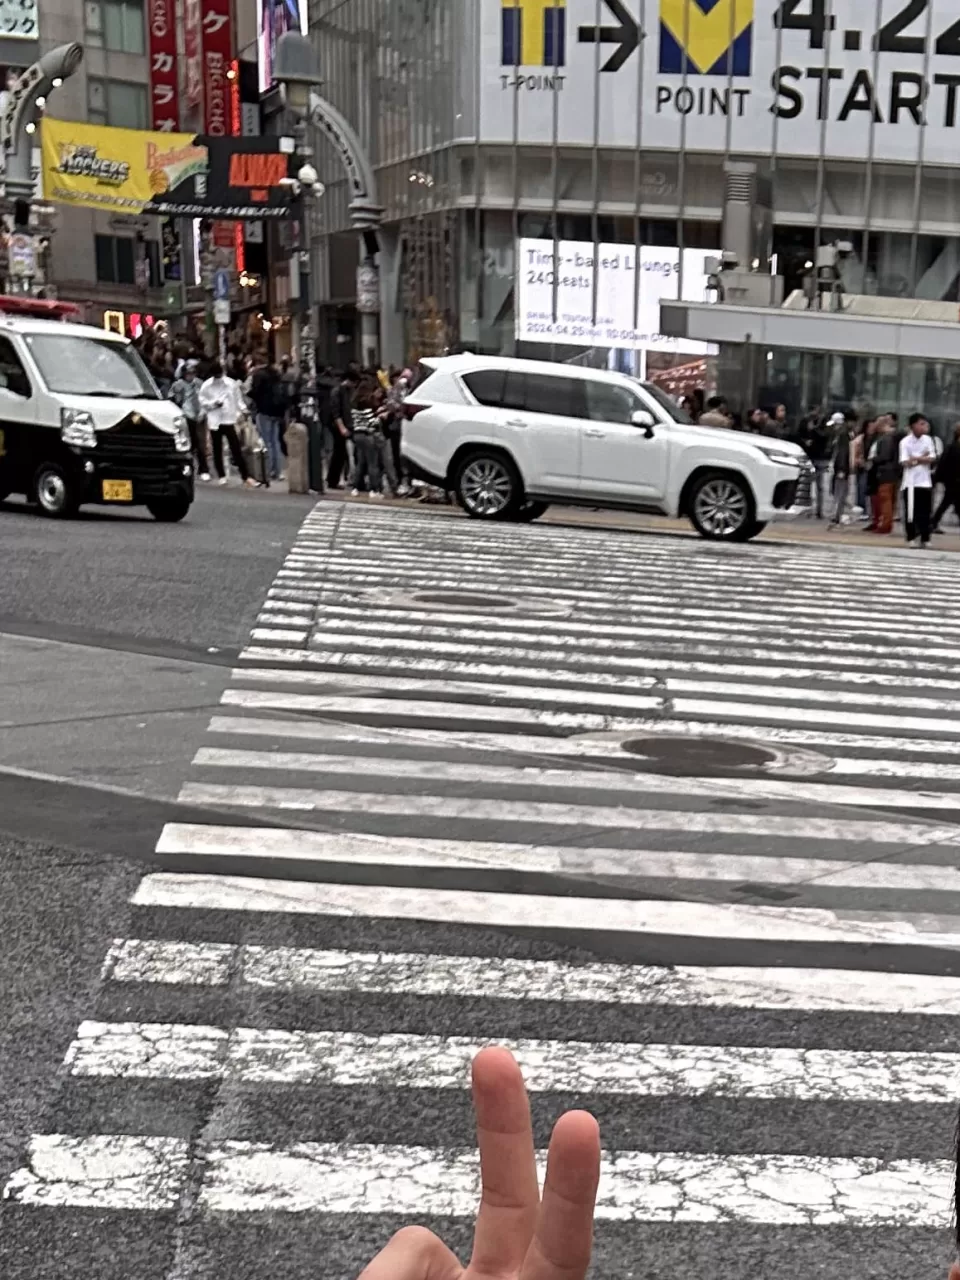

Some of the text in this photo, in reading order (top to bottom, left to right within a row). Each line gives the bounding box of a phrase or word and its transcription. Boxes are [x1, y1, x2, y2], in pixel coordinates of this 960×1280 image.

[500, 74, 567, 92] T-POINT
[655, 85, 752, 117] POINT
[527, 249, 620, 269] Tim-baed
[625, 256, 680, 277] Lunge
